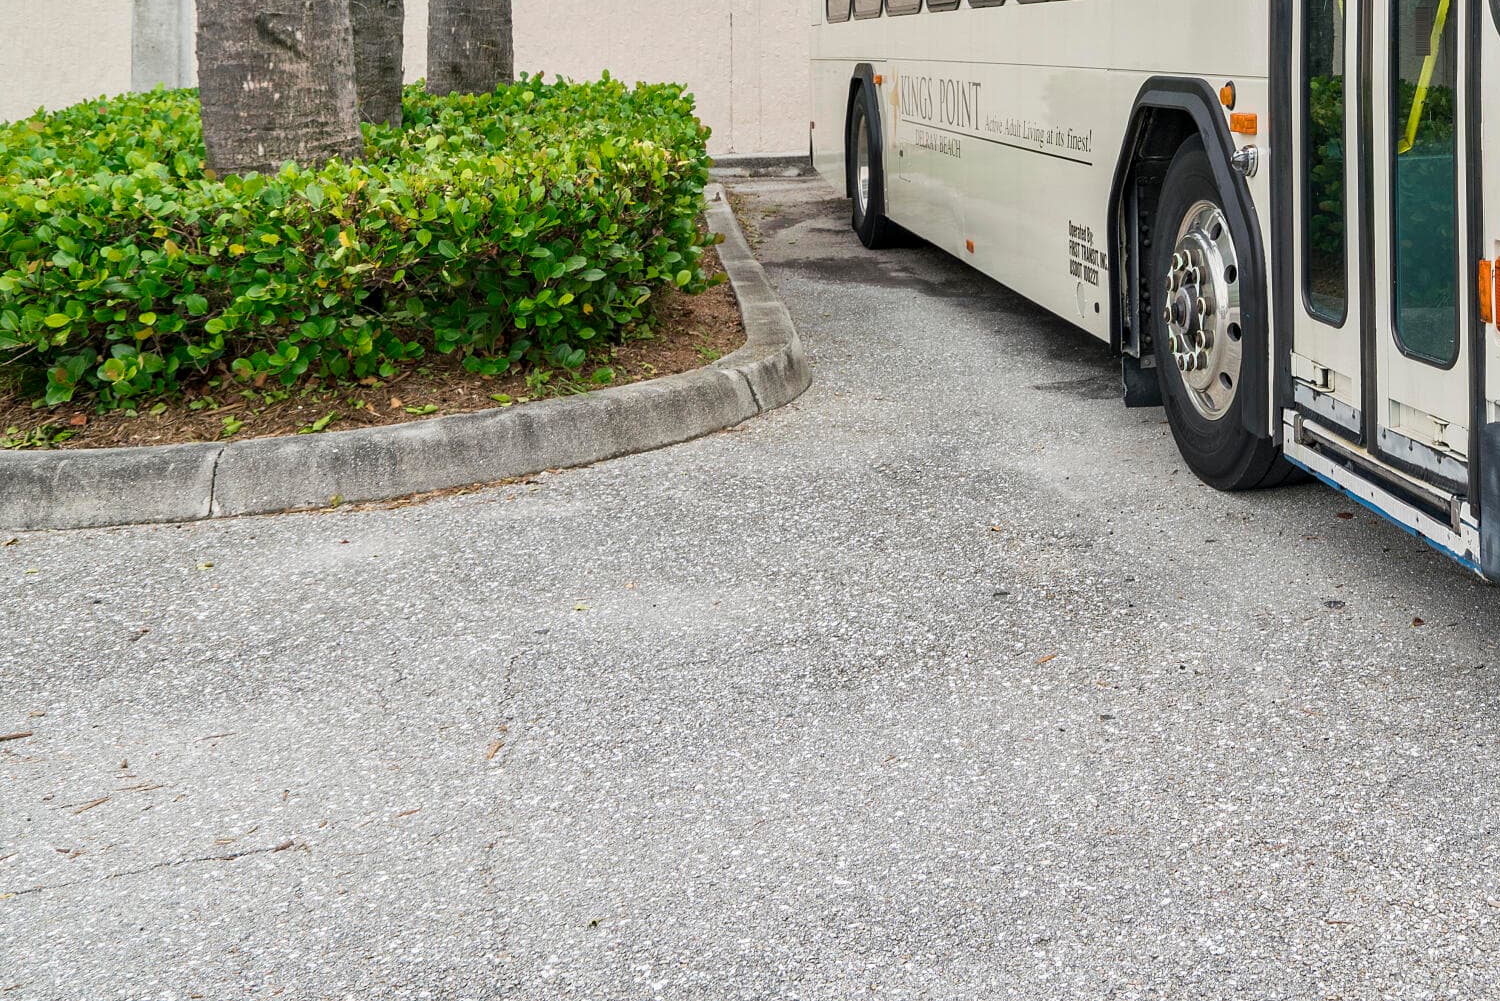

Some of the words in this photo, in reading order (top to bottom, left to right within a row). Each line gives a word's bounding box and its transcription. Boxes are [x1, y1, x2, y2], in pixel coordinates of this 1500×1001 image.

[900, 75, 933, 121] KINGS
[939, 78, 981, 131] POINT
[915, 128, 938, 152] DELRAY
[939, 135, 961, 159] BEACH
[984, 112, 1003, 135] Active
[1004, 118, 1022, 138] Adult
[1023, 120, 1045, 148] Living
[1046, 129, 1054, 145] at
[1055, 125, 1065, 147] its
[1067, 128, 1093, 153] finest!
